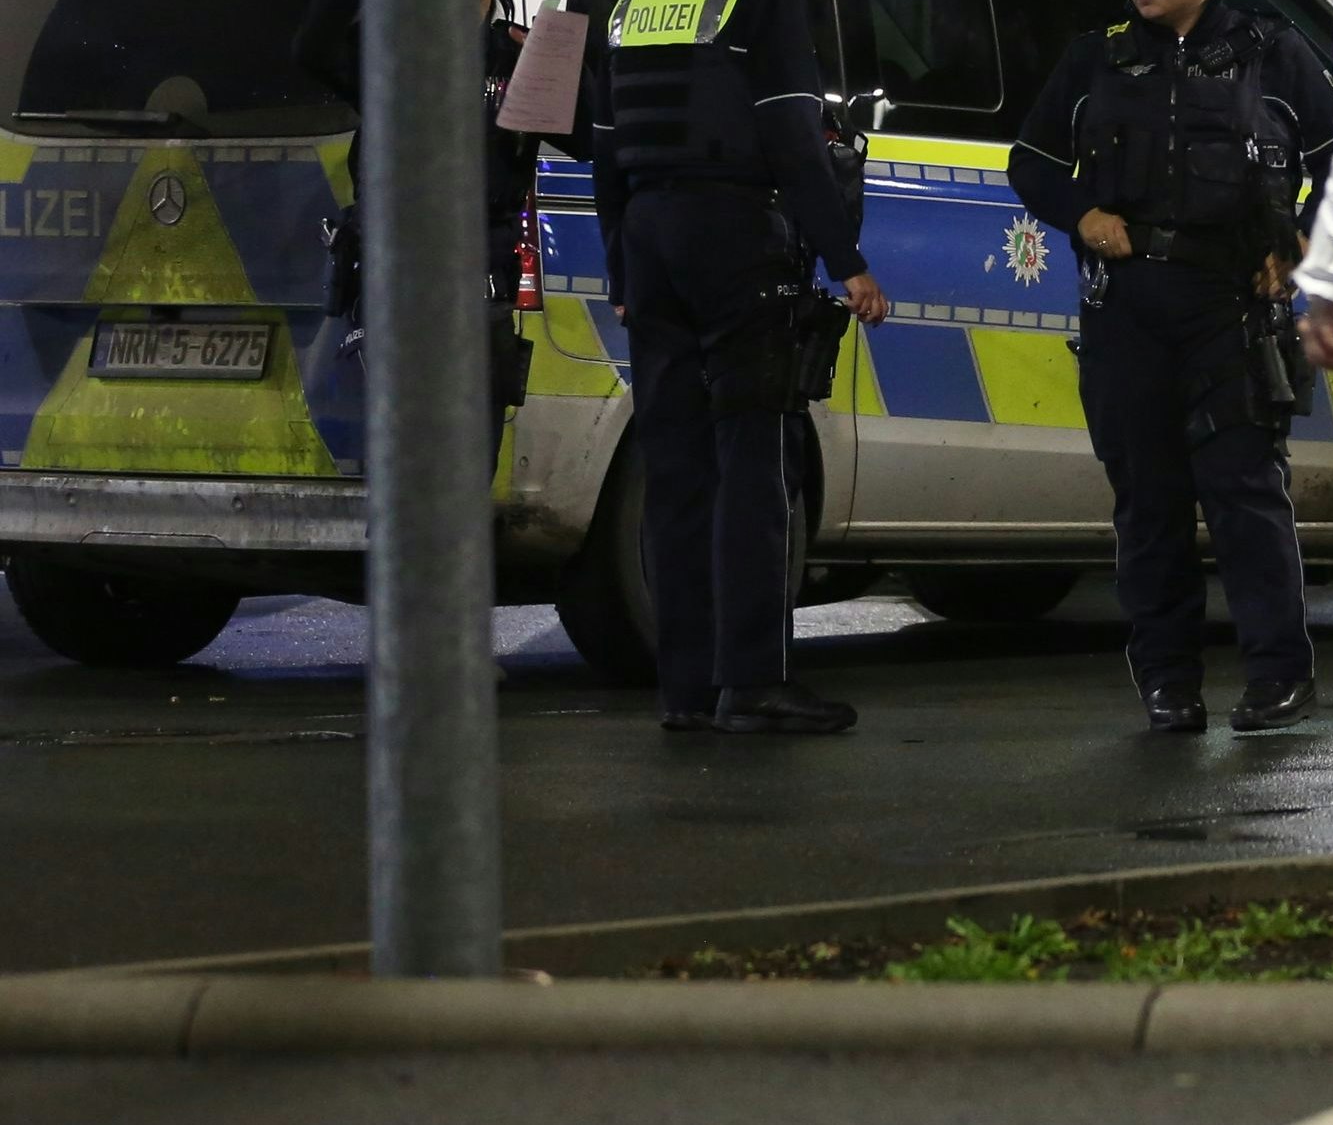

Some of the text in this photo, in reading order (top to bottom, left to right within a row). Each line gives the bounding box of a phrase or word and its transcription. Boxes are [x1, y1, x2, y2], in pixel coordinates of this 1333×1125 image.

[626, 3, 697, 35] POLIZEI
[109, 329, 267, 367] NRW 5-6275
